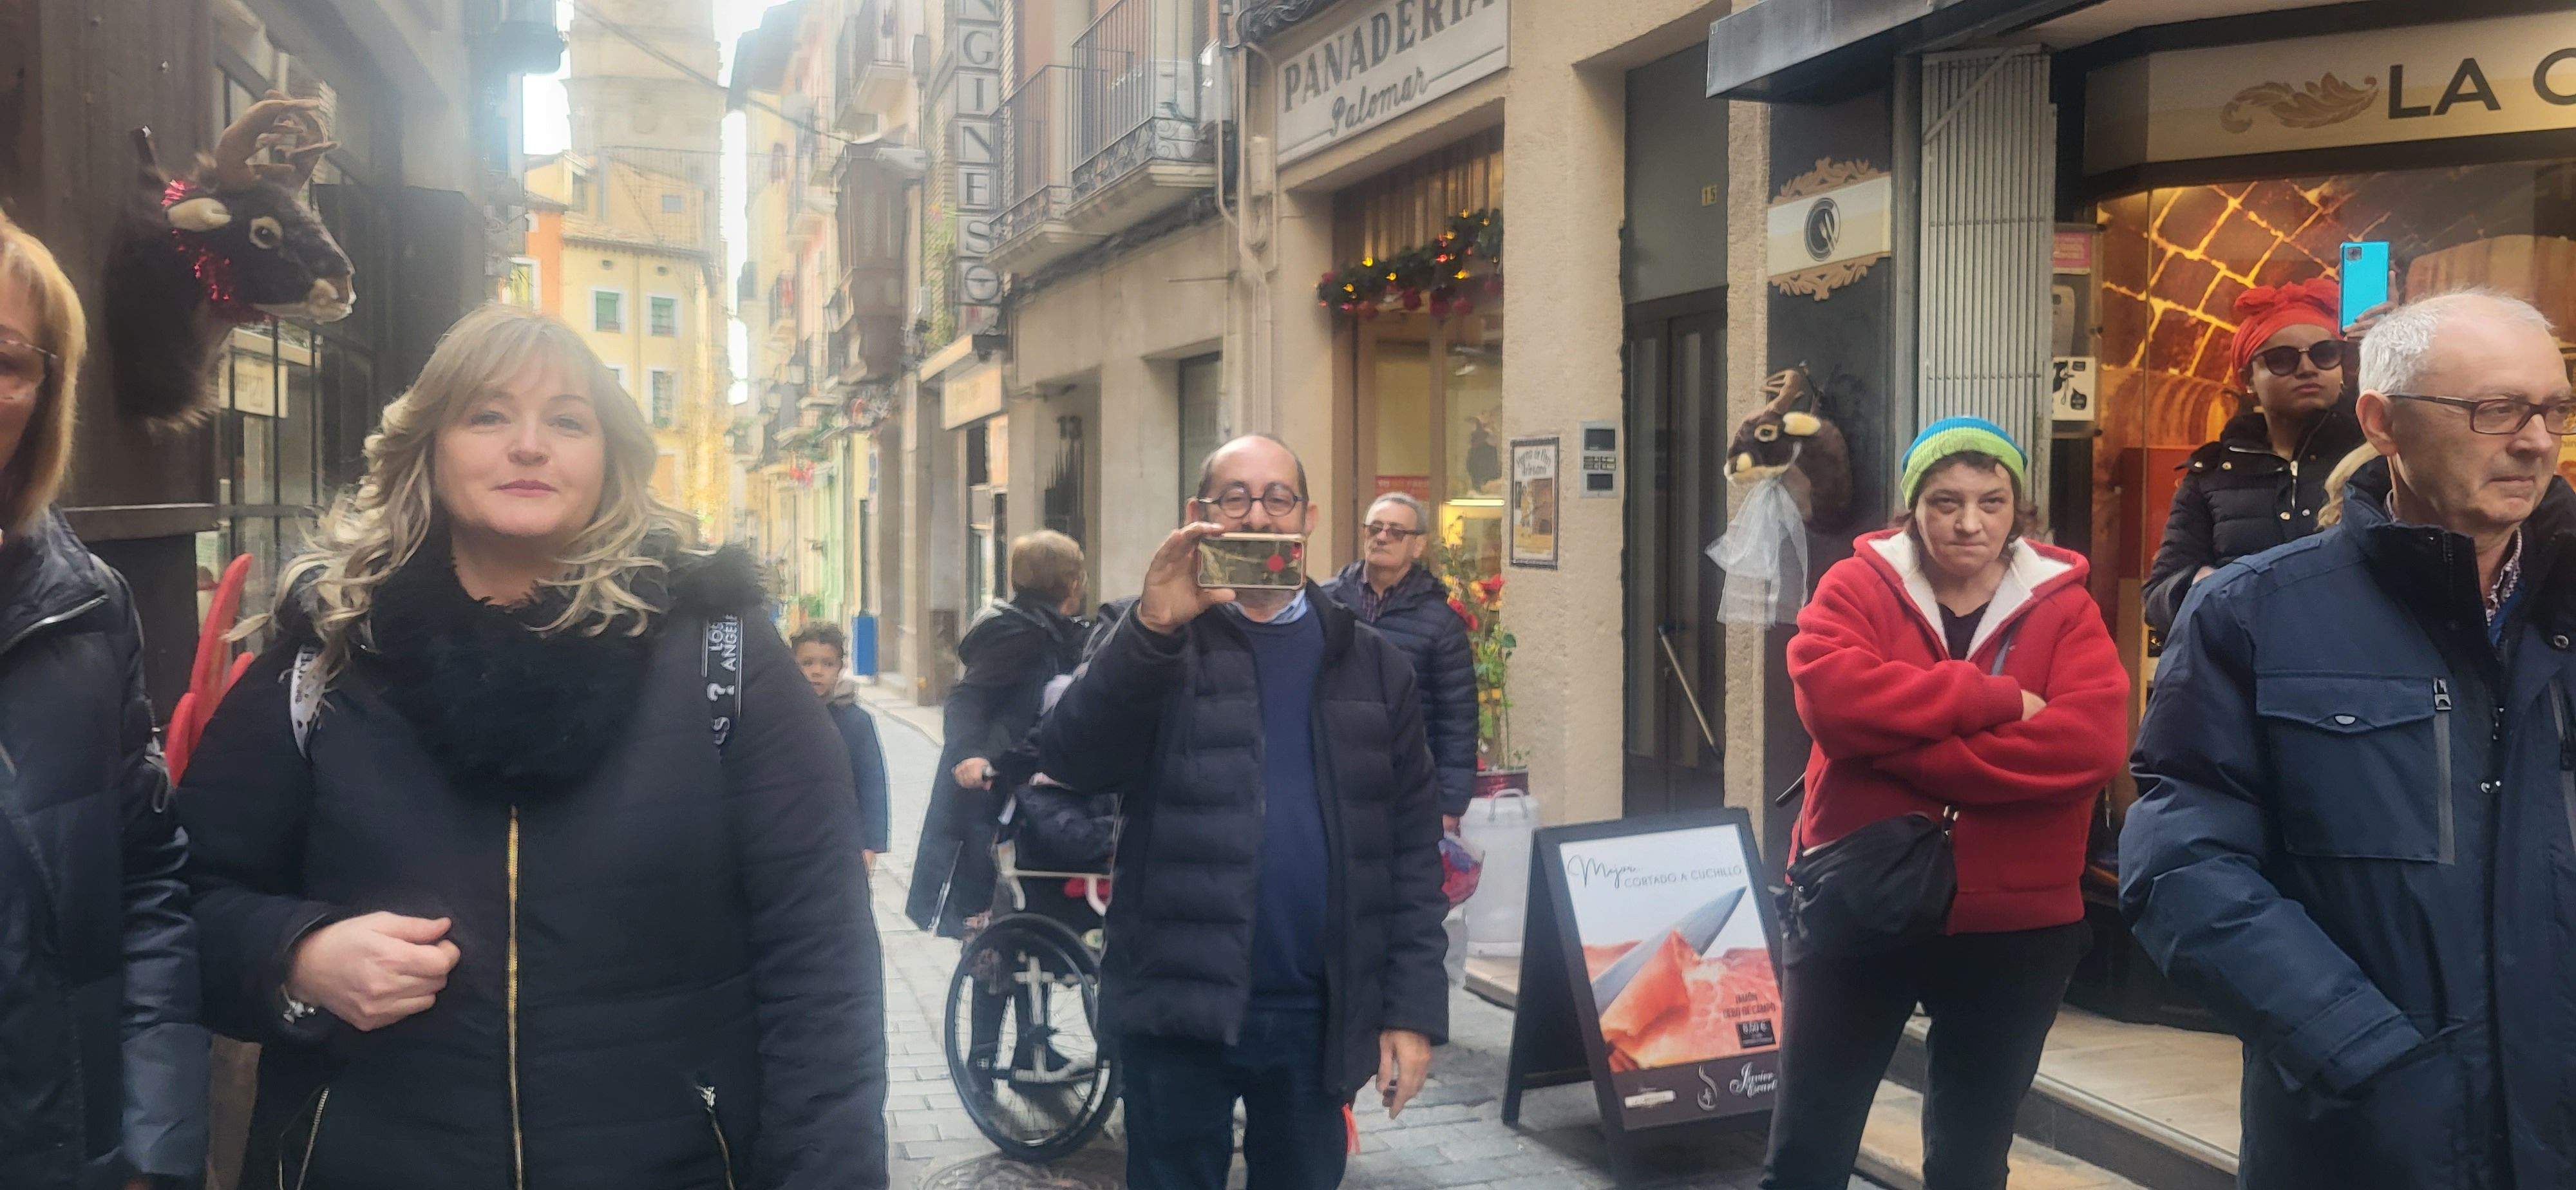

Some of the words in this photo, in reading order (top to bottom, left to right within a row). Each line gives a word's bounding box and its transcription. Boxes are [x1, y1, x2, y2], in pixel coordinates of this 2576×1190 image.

[1330, 66, 1427, 137] Palomar
[2388, 57, 2501, 119] LA
[1703, 186, 1716, 204] 15
[1624, 873, 1676, 888] CORTADO
[1680, 873, 1687, 882] A
[1690, 865, 1742, 880] CUCHILLO
